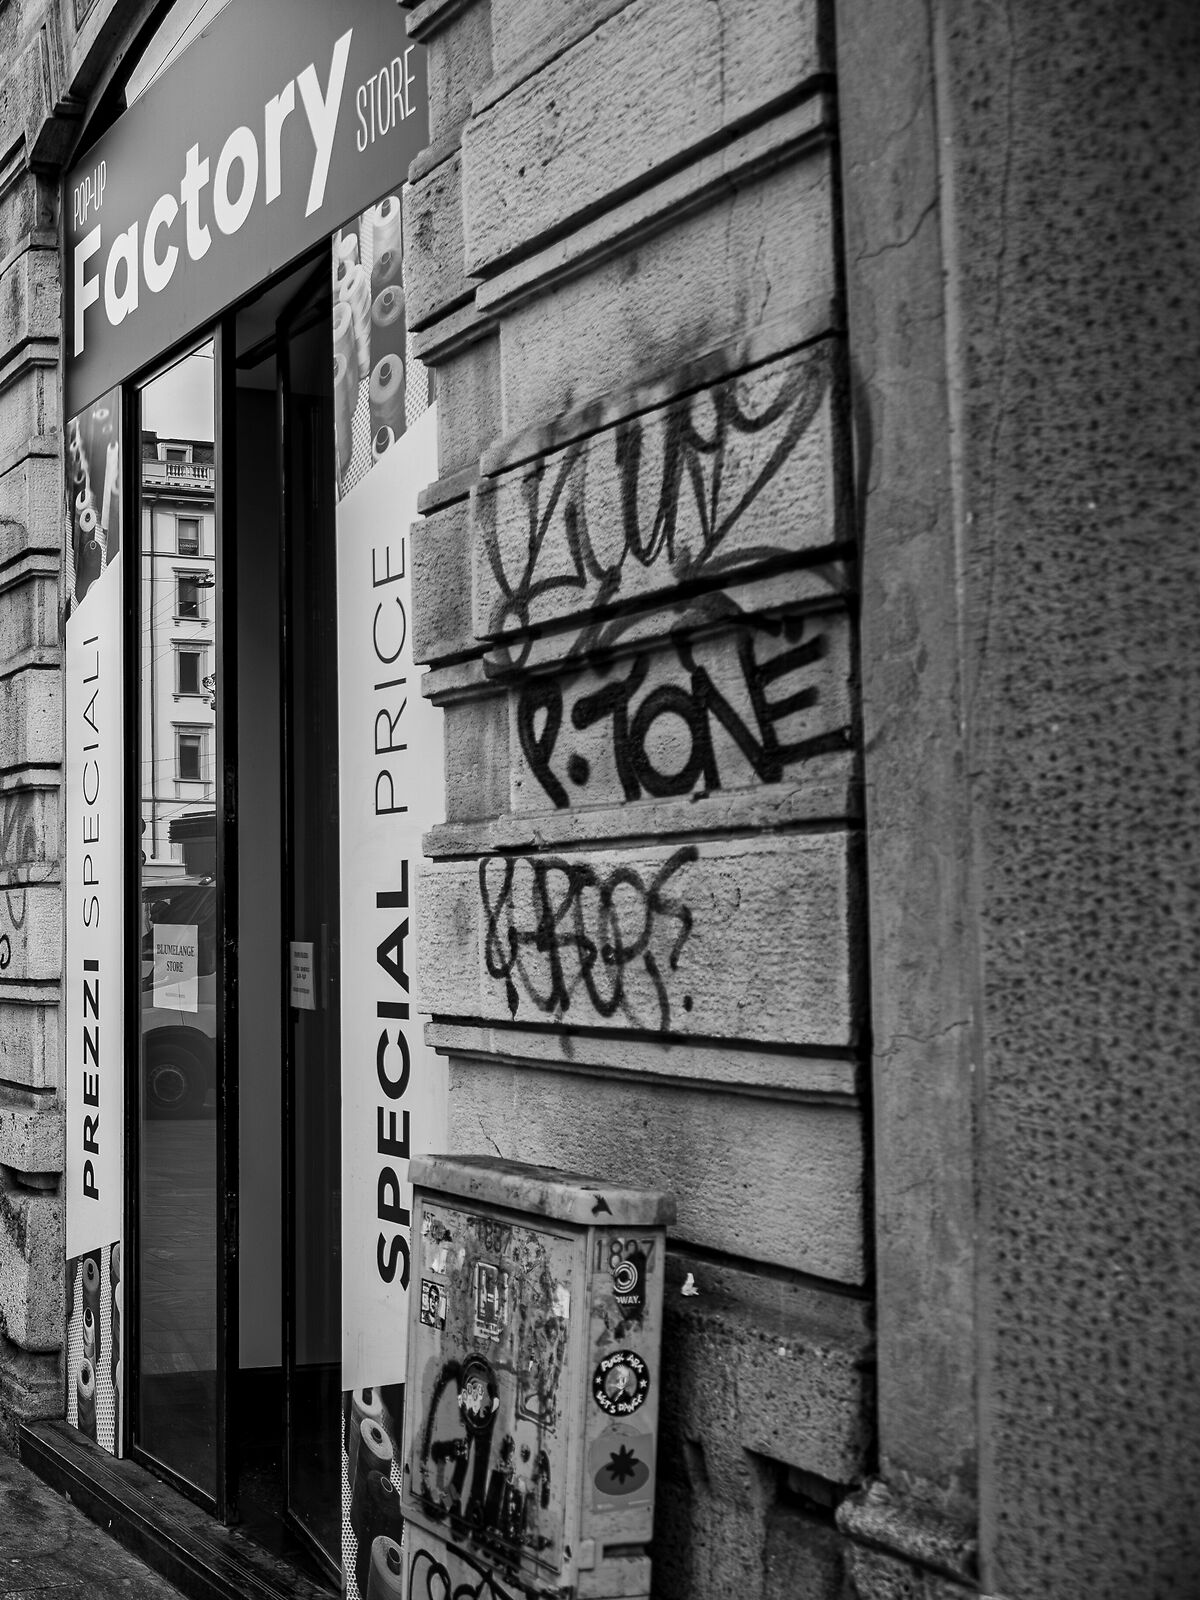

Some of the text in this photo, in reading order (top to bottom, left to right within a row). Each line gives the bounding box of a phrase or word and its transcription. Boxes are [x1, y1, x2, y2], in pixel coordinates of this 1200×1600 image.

[73, 28, 417, 358] Factory STORE
[73, 160, 108, 232] POP-UP
[82, 635, 100, 1201] PREZZI SPECIALI
[156, 943, 195, 957] BLUMELANGE
[166, 961, 184, 972] STORE
[371, 537, 411, 1291] SPECIAL PRICE
